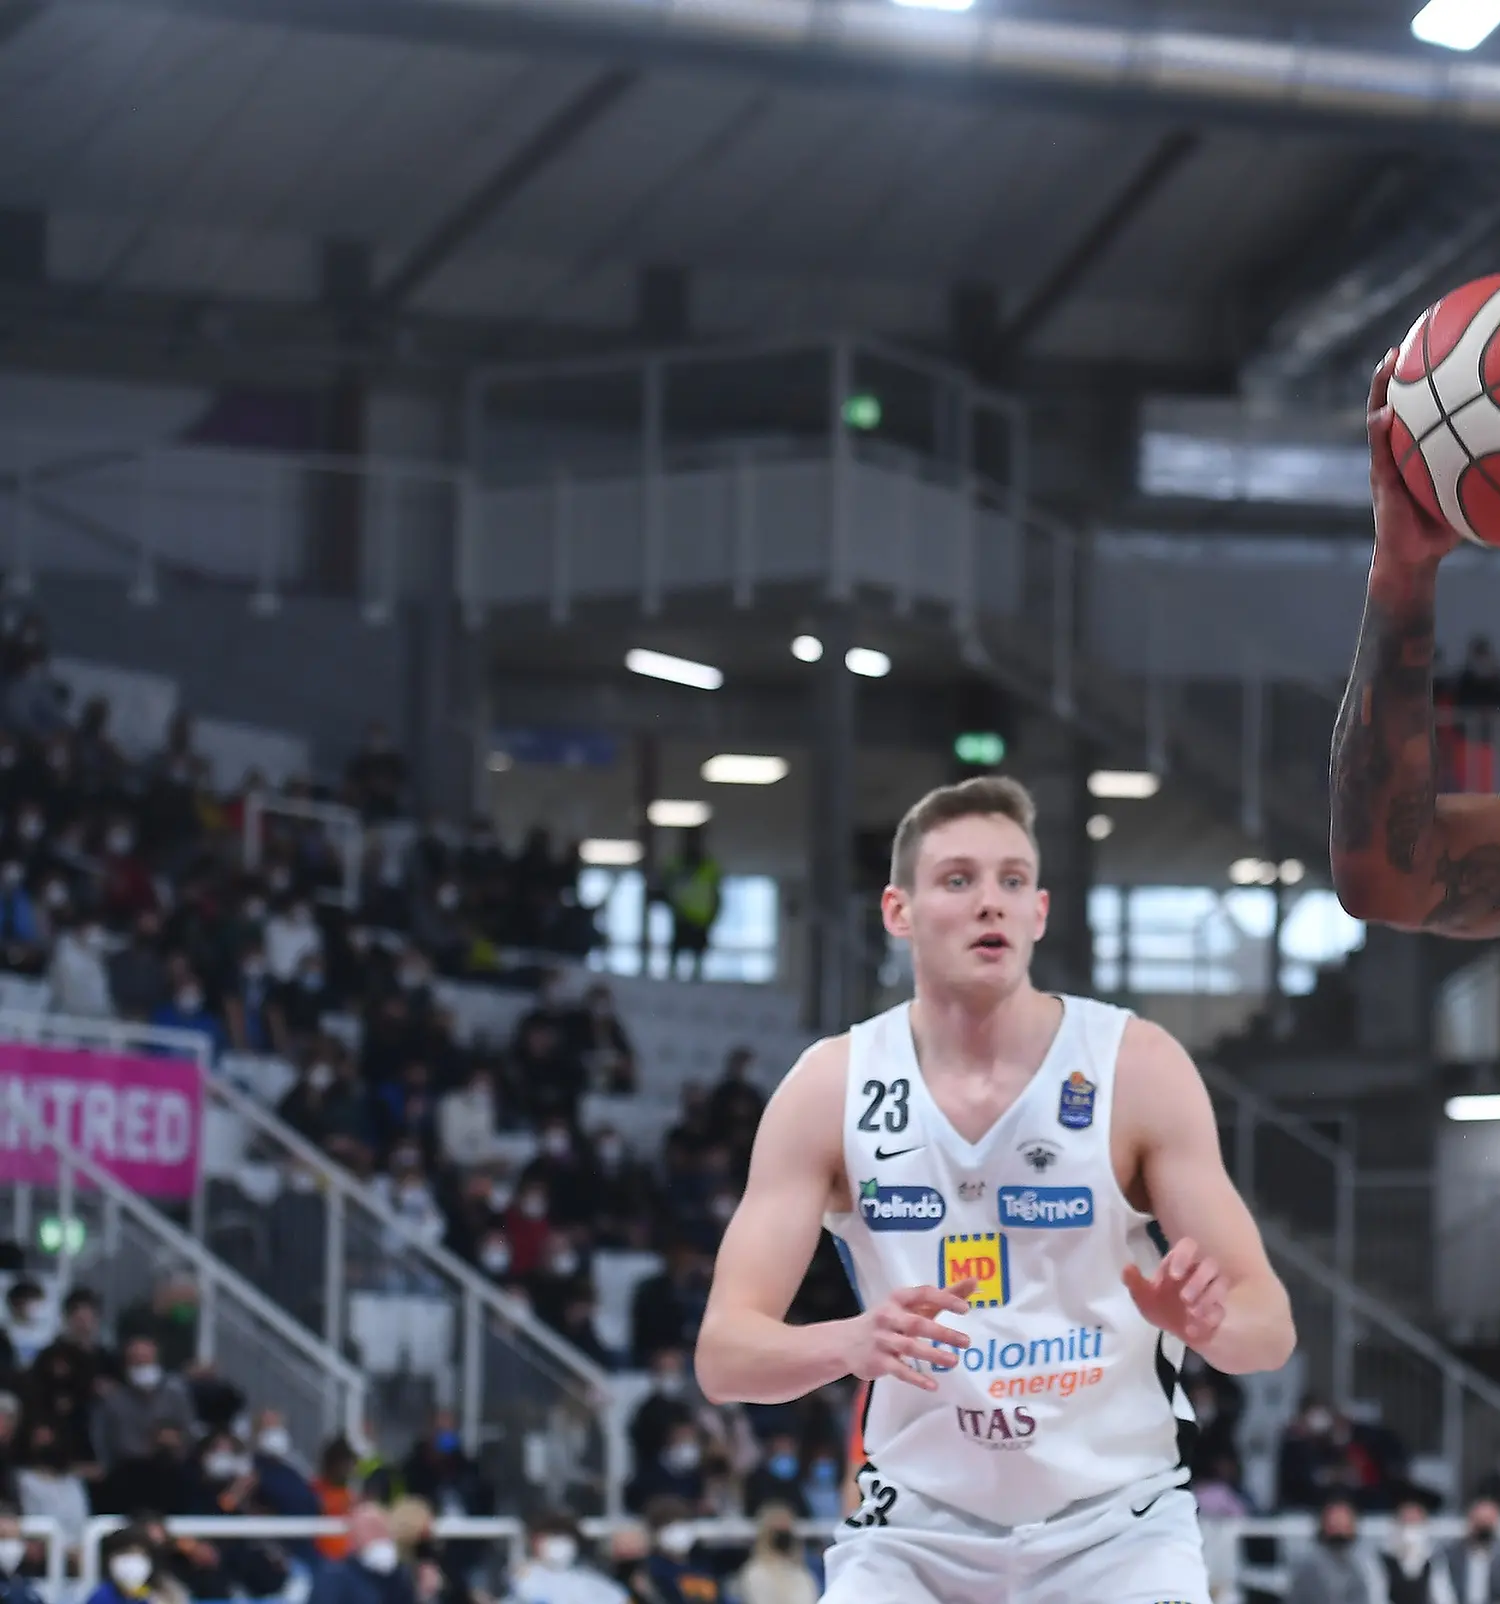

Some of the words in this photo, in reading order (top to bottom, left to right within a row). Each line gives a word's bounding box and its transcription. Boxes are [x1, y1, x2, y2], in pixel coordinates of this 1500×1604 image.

[857, 1078, 910, 1133] 23
[861, 1195, 943, 1219] Melinda
[1002, 1192, 1089, 1222] TRENTINO
[949, 1256, 996, 1282] MD
[988, 1366, 1104, 1398] energia
[956, 1405, 1036, 1440] ITAS
